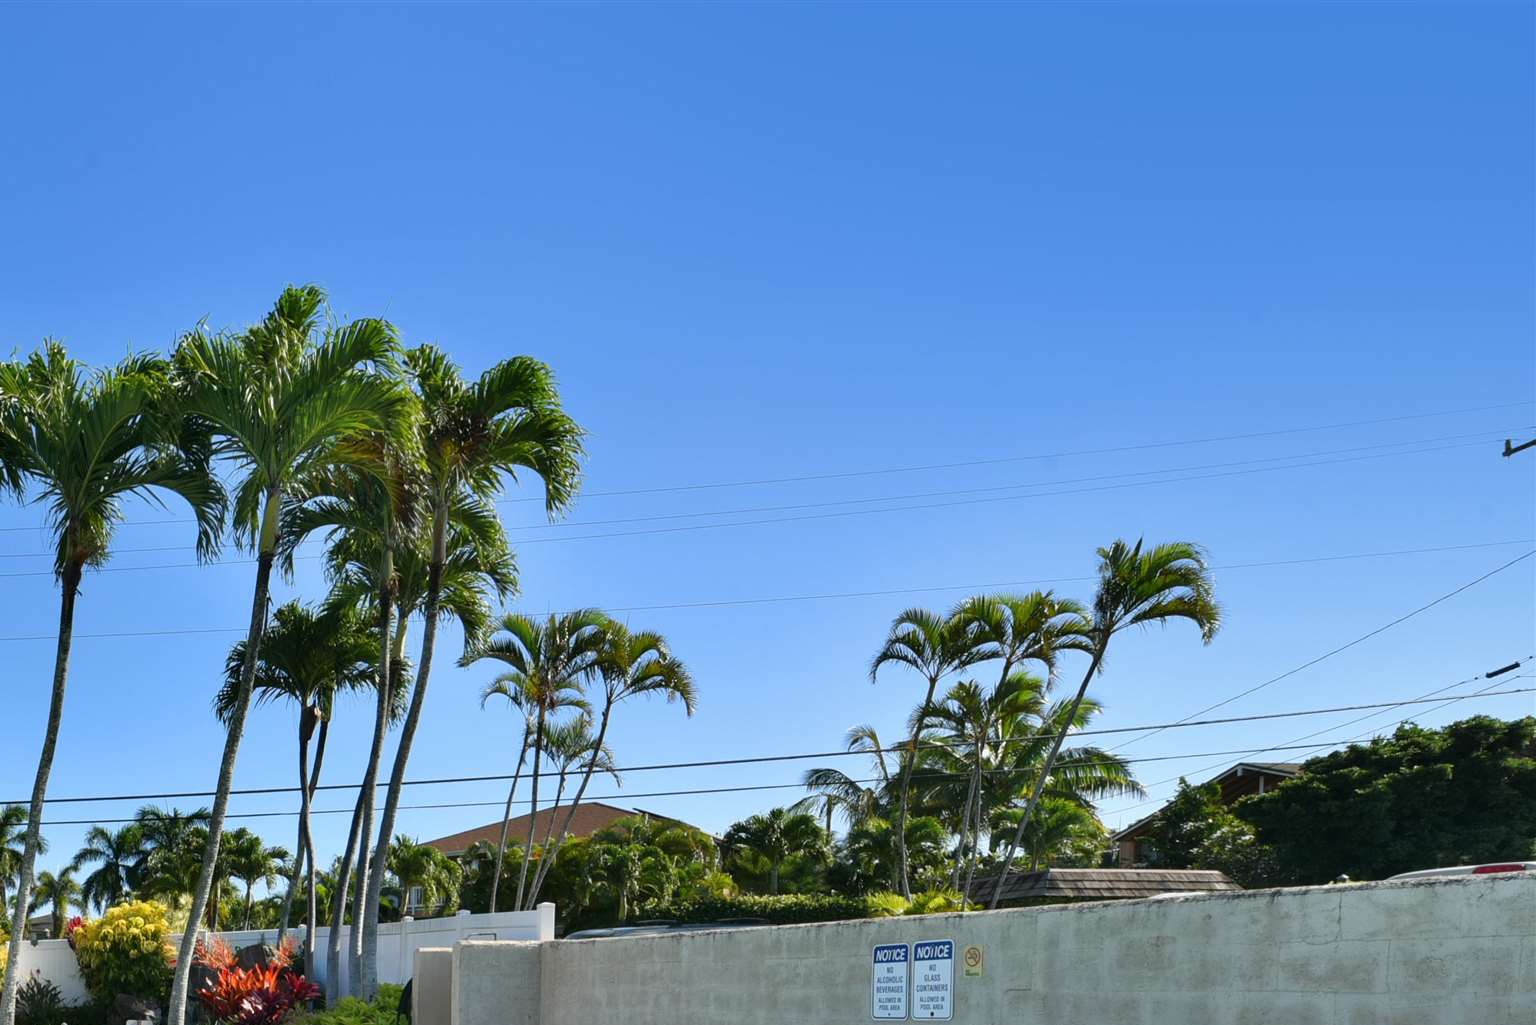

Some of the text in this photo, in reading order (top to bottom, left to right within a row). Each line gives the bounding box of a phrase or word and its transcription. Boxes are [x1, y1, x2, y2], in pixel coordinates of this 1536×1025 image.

[875, 948, 906, 961] NOTICE
[916, 945, 950, 959] NOTICE
[877, 976, 903, 984] ALCOHOLIC
[924, 974, 941, 982] GLASS
[916, 984, 948, 992] CONTAINERS
